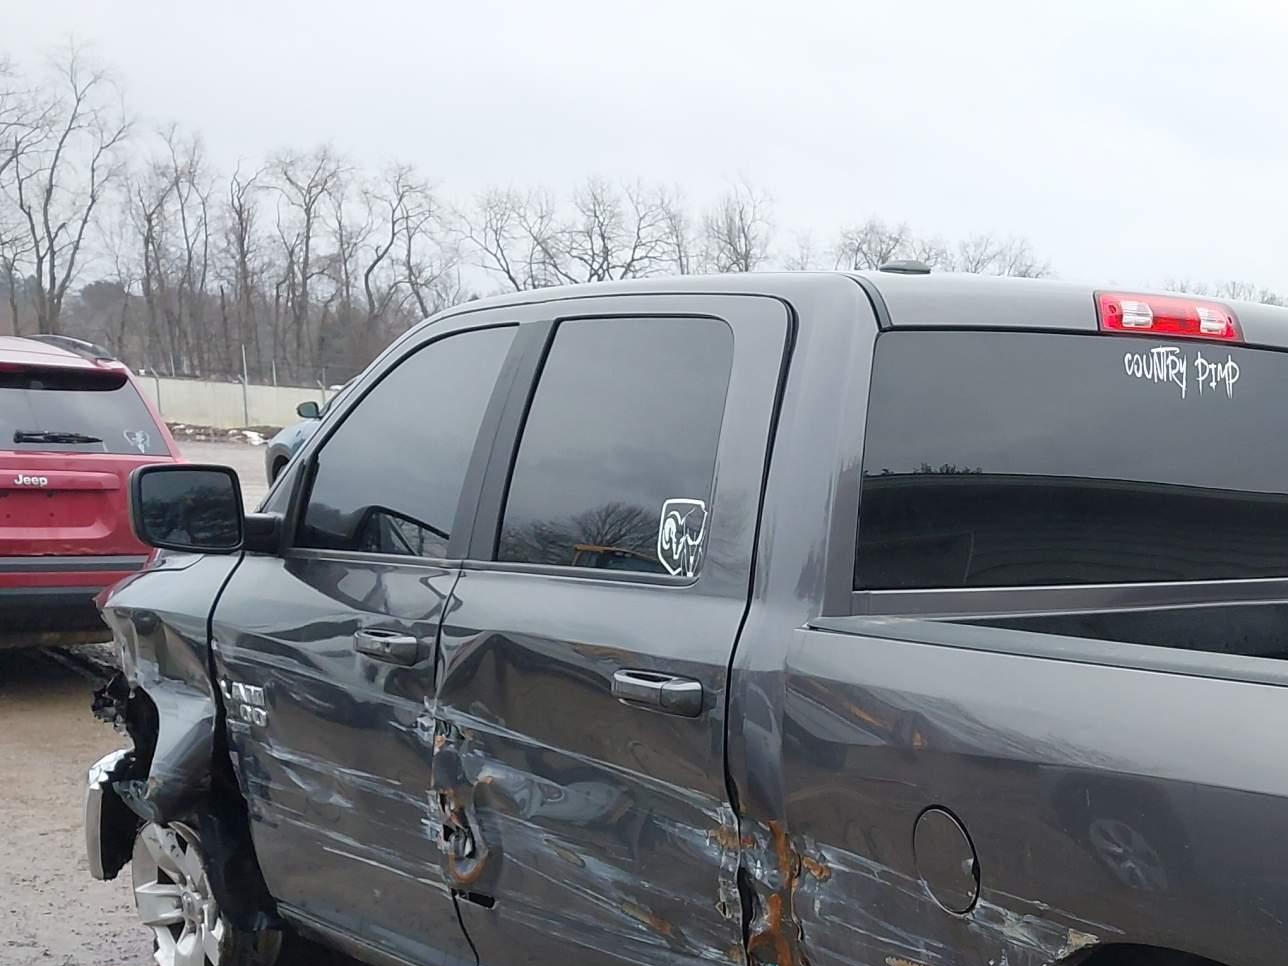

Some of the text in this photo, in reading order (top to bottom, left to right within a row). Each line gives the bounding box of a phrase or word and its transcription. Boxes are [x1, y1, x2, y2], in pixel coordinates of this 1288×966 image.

[1124, 346, 1239, 399] COUNTRY PIMP
[14, 473, 48, 487] Jeep
